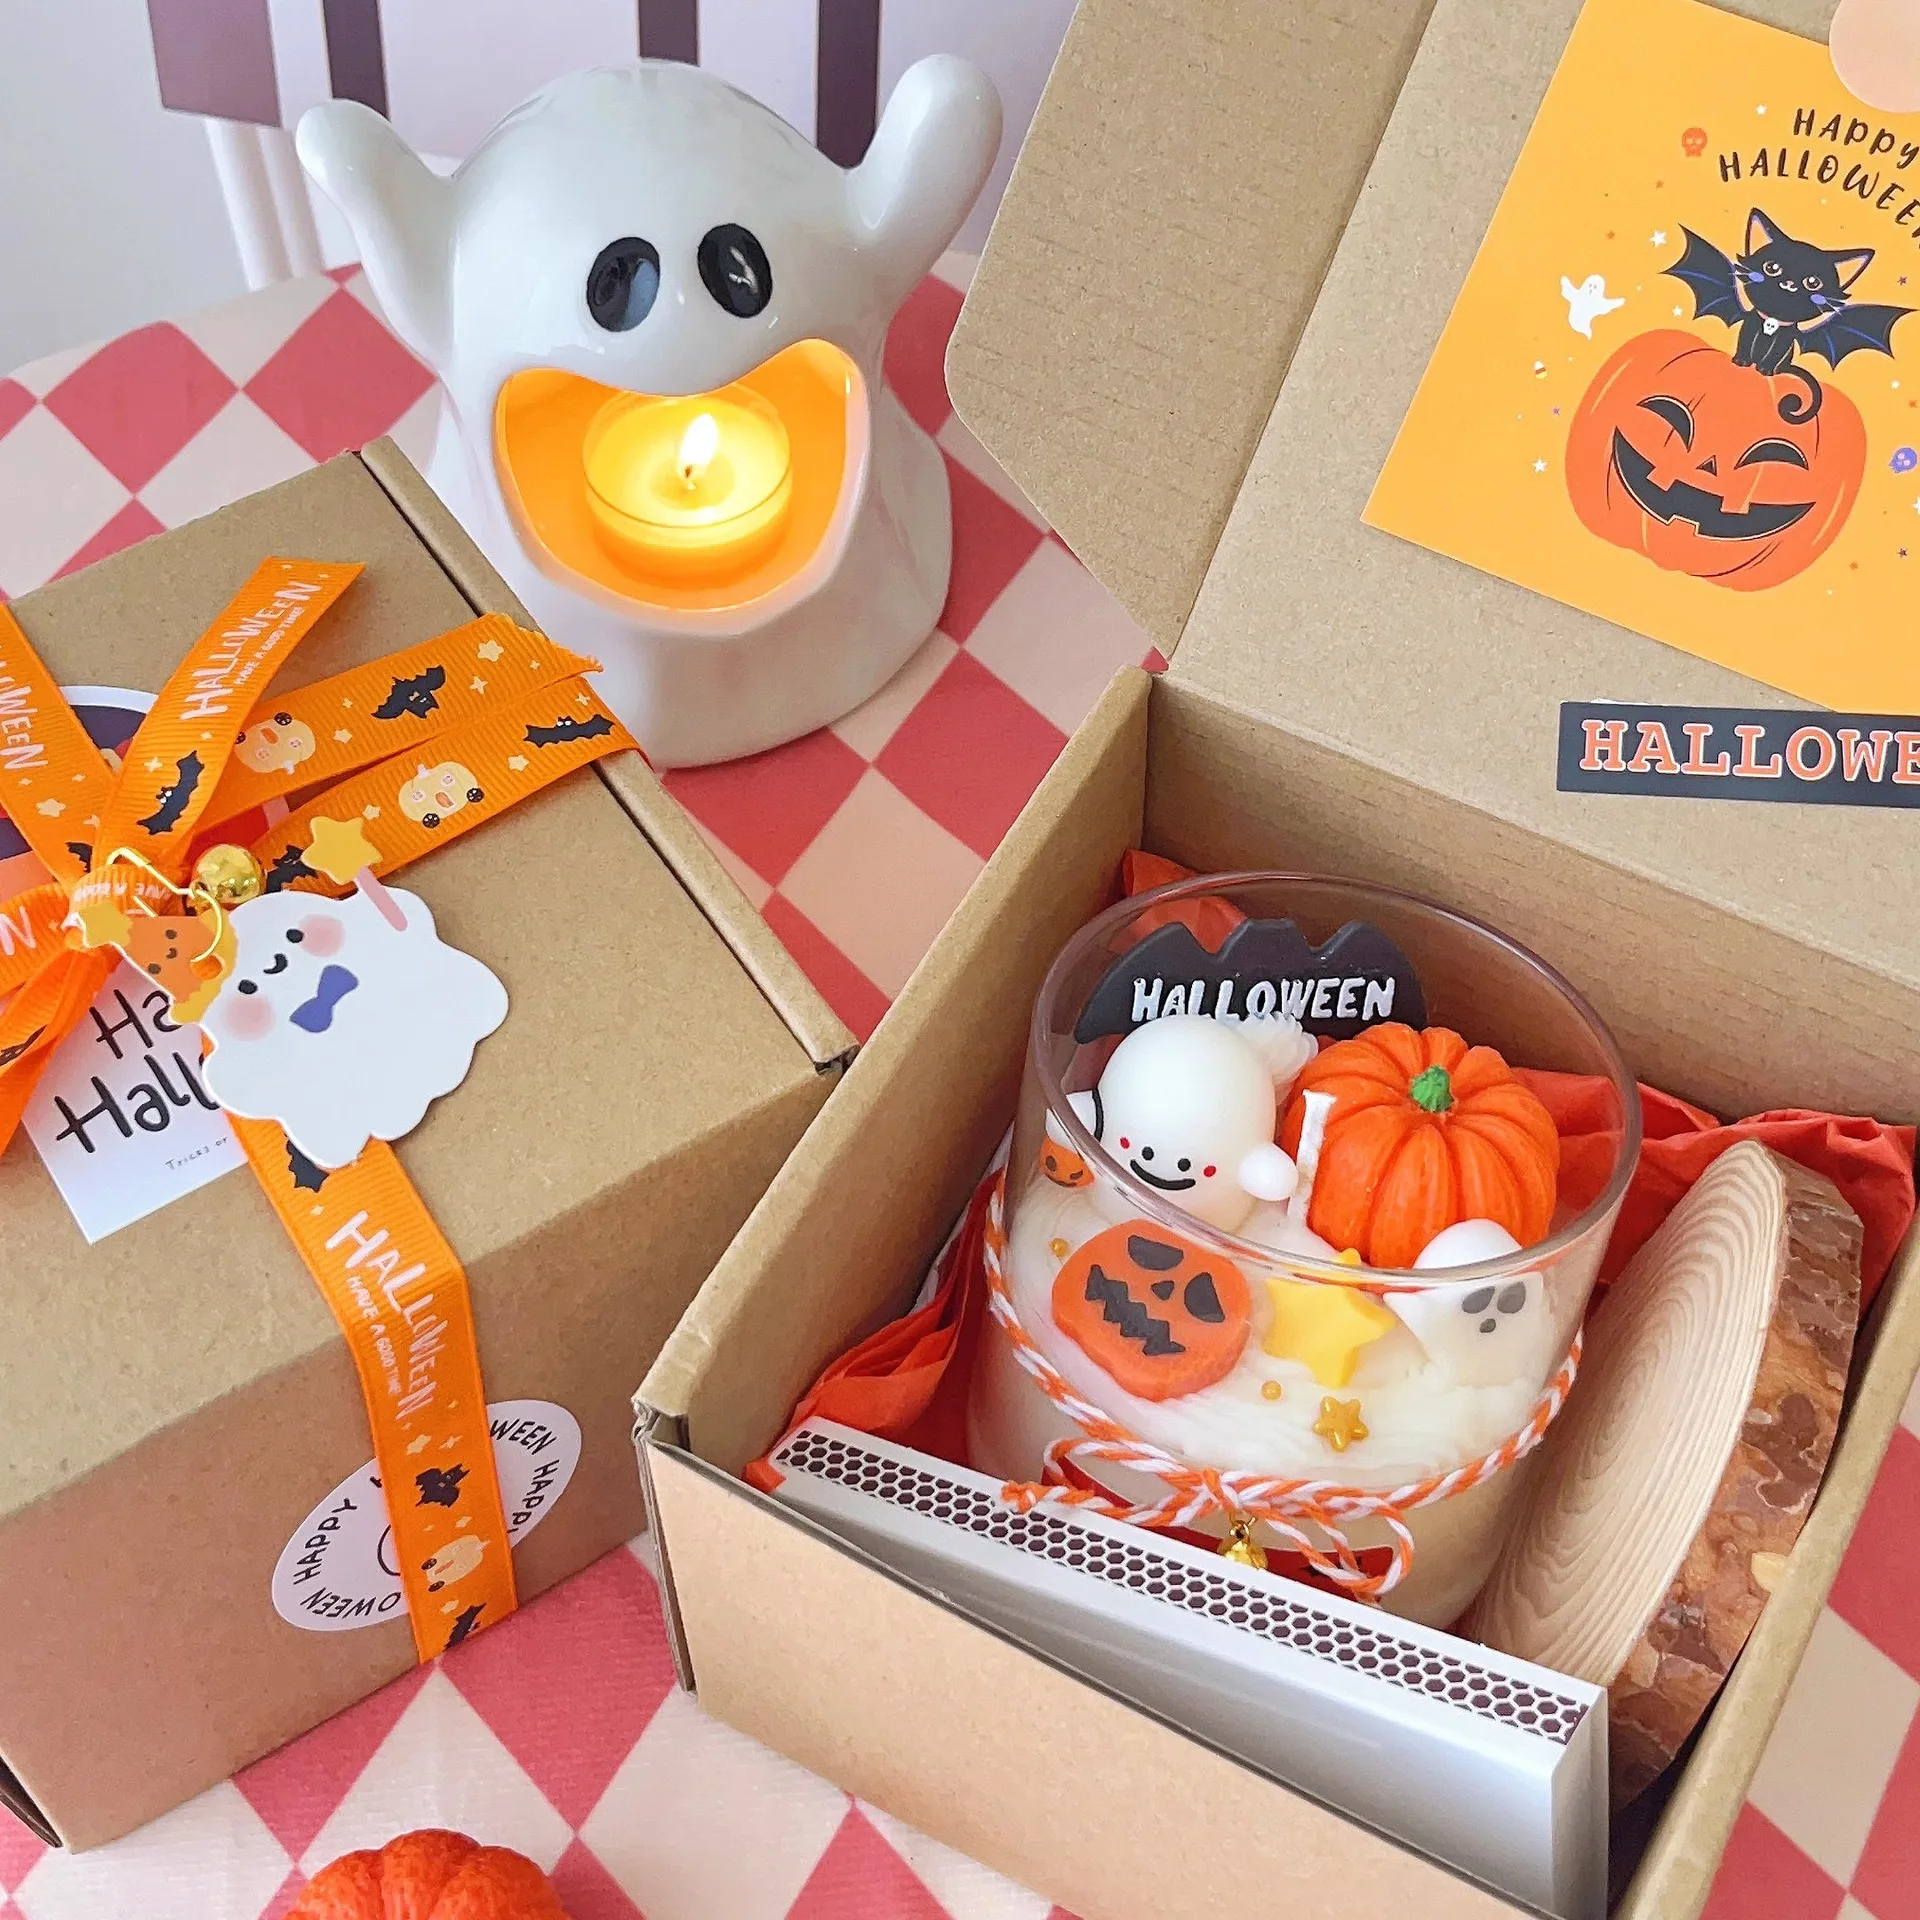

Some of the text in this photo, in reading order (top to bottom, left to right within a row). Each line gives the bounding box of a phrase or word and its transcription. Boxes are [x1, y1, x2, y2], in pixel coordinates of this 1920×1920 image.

[179, 581, 322, 721] HALLOWEEN
[1131, 977, 1395, 1021] HALLOWEEN
[325, 1210, 448, 1420] HALLOWEEN
[345, 1275, 380, 1320] HAVE
[370, 1323, 387, 1337] A
[293, 1498, 358, 1585] HAPPY
